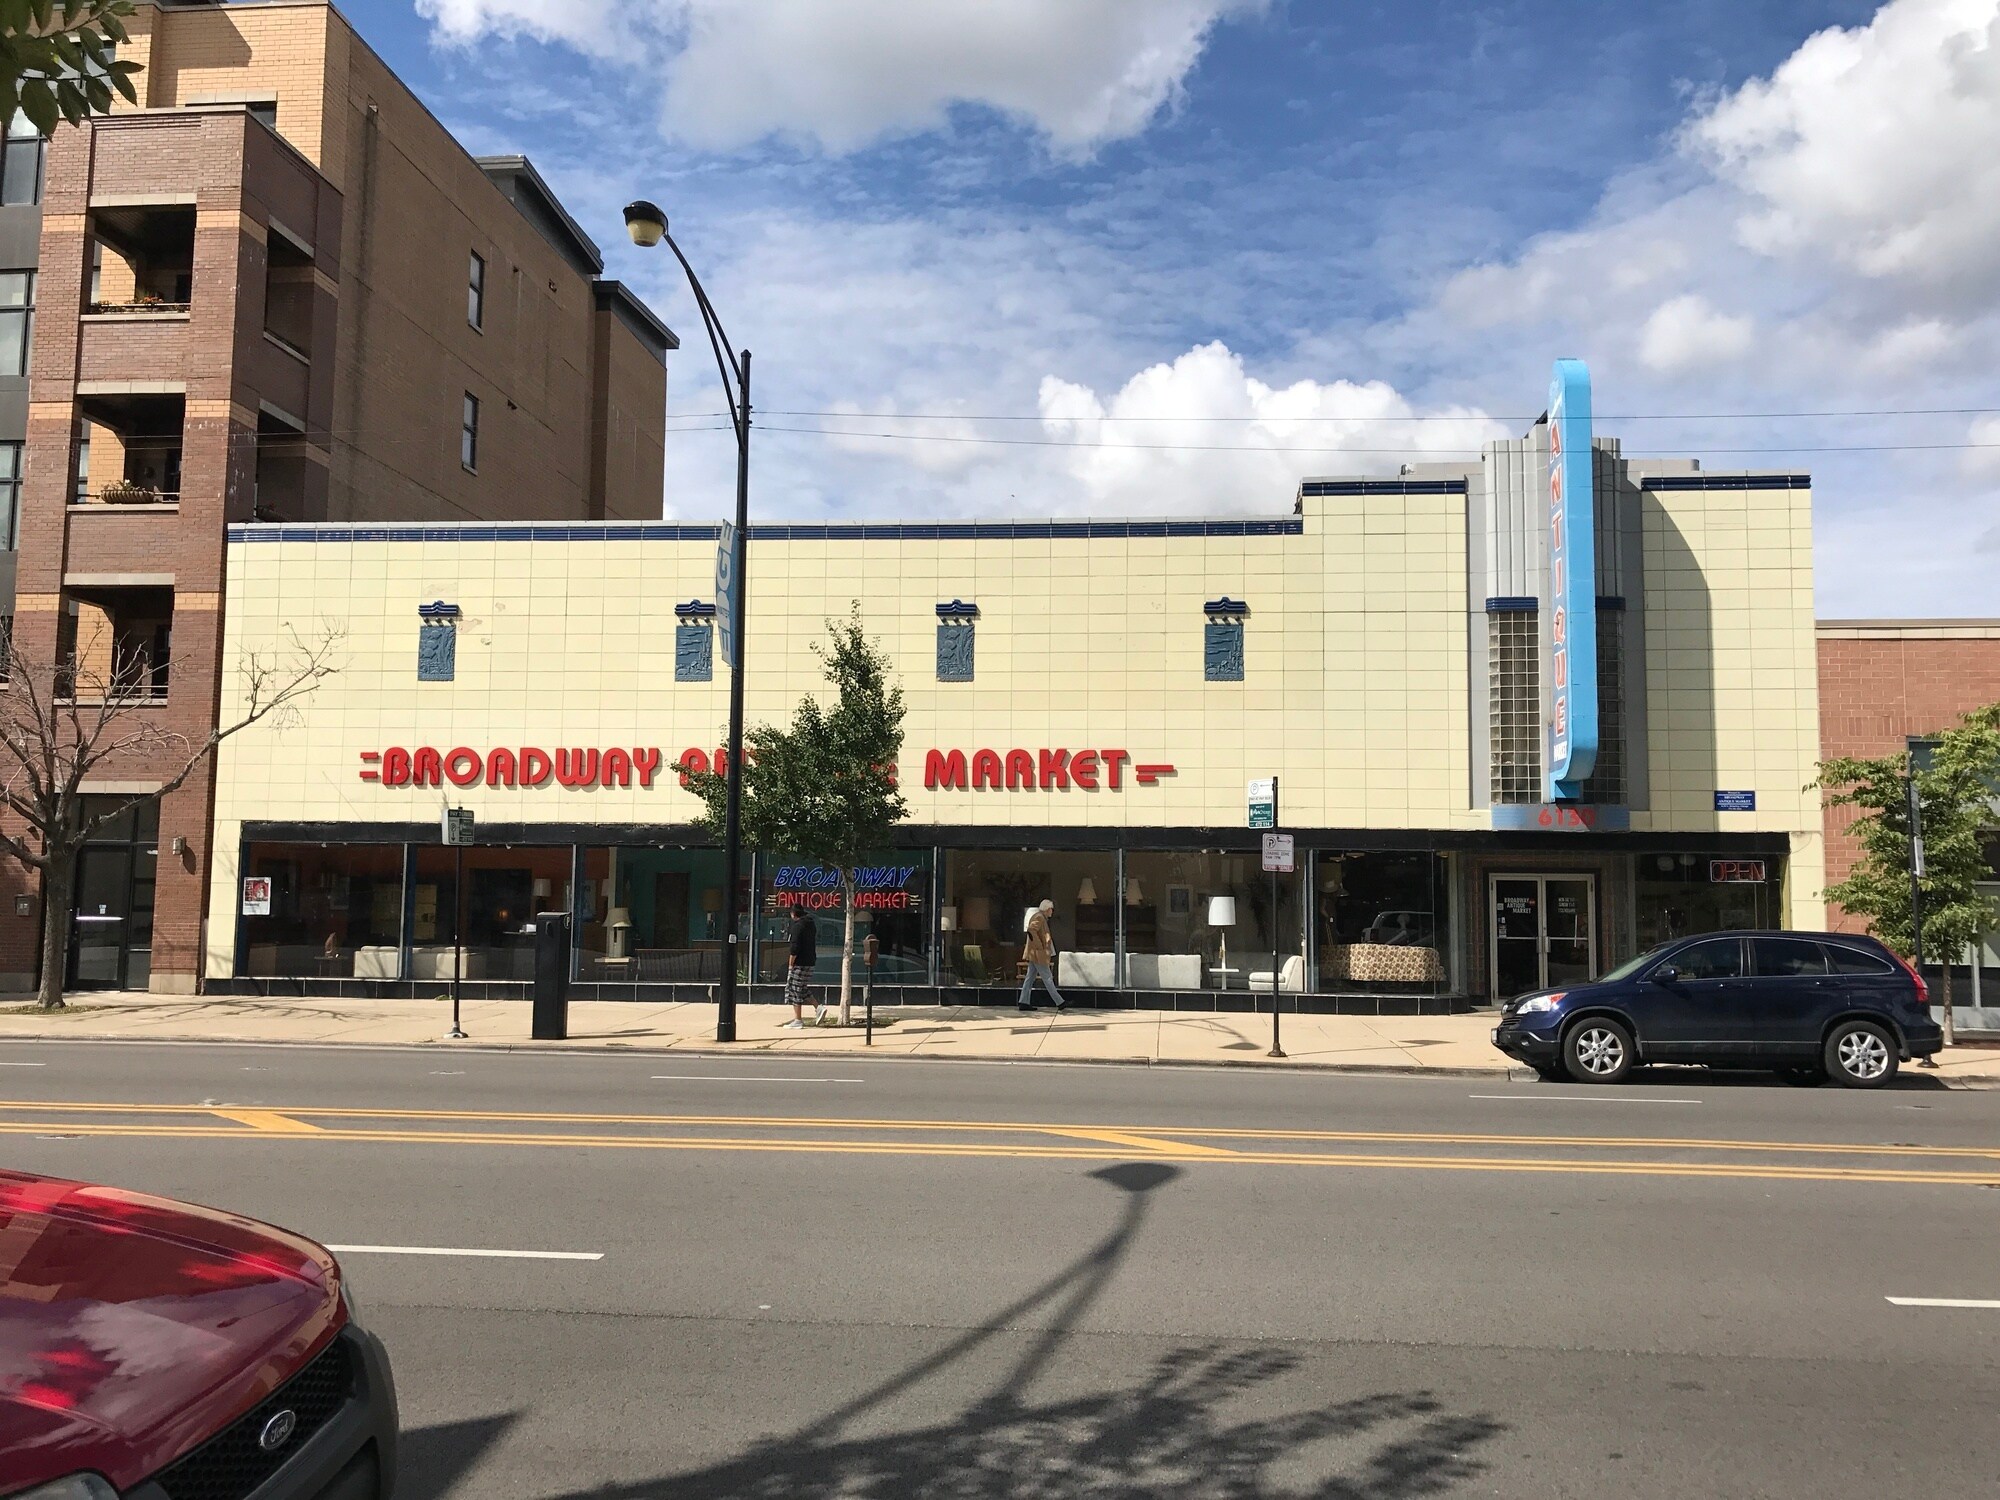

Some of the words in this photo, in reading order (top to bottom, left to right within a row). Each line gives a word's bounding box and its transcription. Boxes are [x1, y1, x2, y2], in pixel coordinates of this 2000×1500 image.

[1549, 420, 1567, 737] ANTIQUE
[382, 747, 660, 786] BROADWAY
[924, 748, 1128, 788] MARKET
[1538, 807, 1596, 827] 6130
[774, 866, 914, 887] BROADWAY
[1712, 862, 1764, 881] OPEN
[778, 892, 841, 910] ANTIQUE
[853, 892, 908, 908] MARKET
[270, 1417, 288, 1442] Ford
